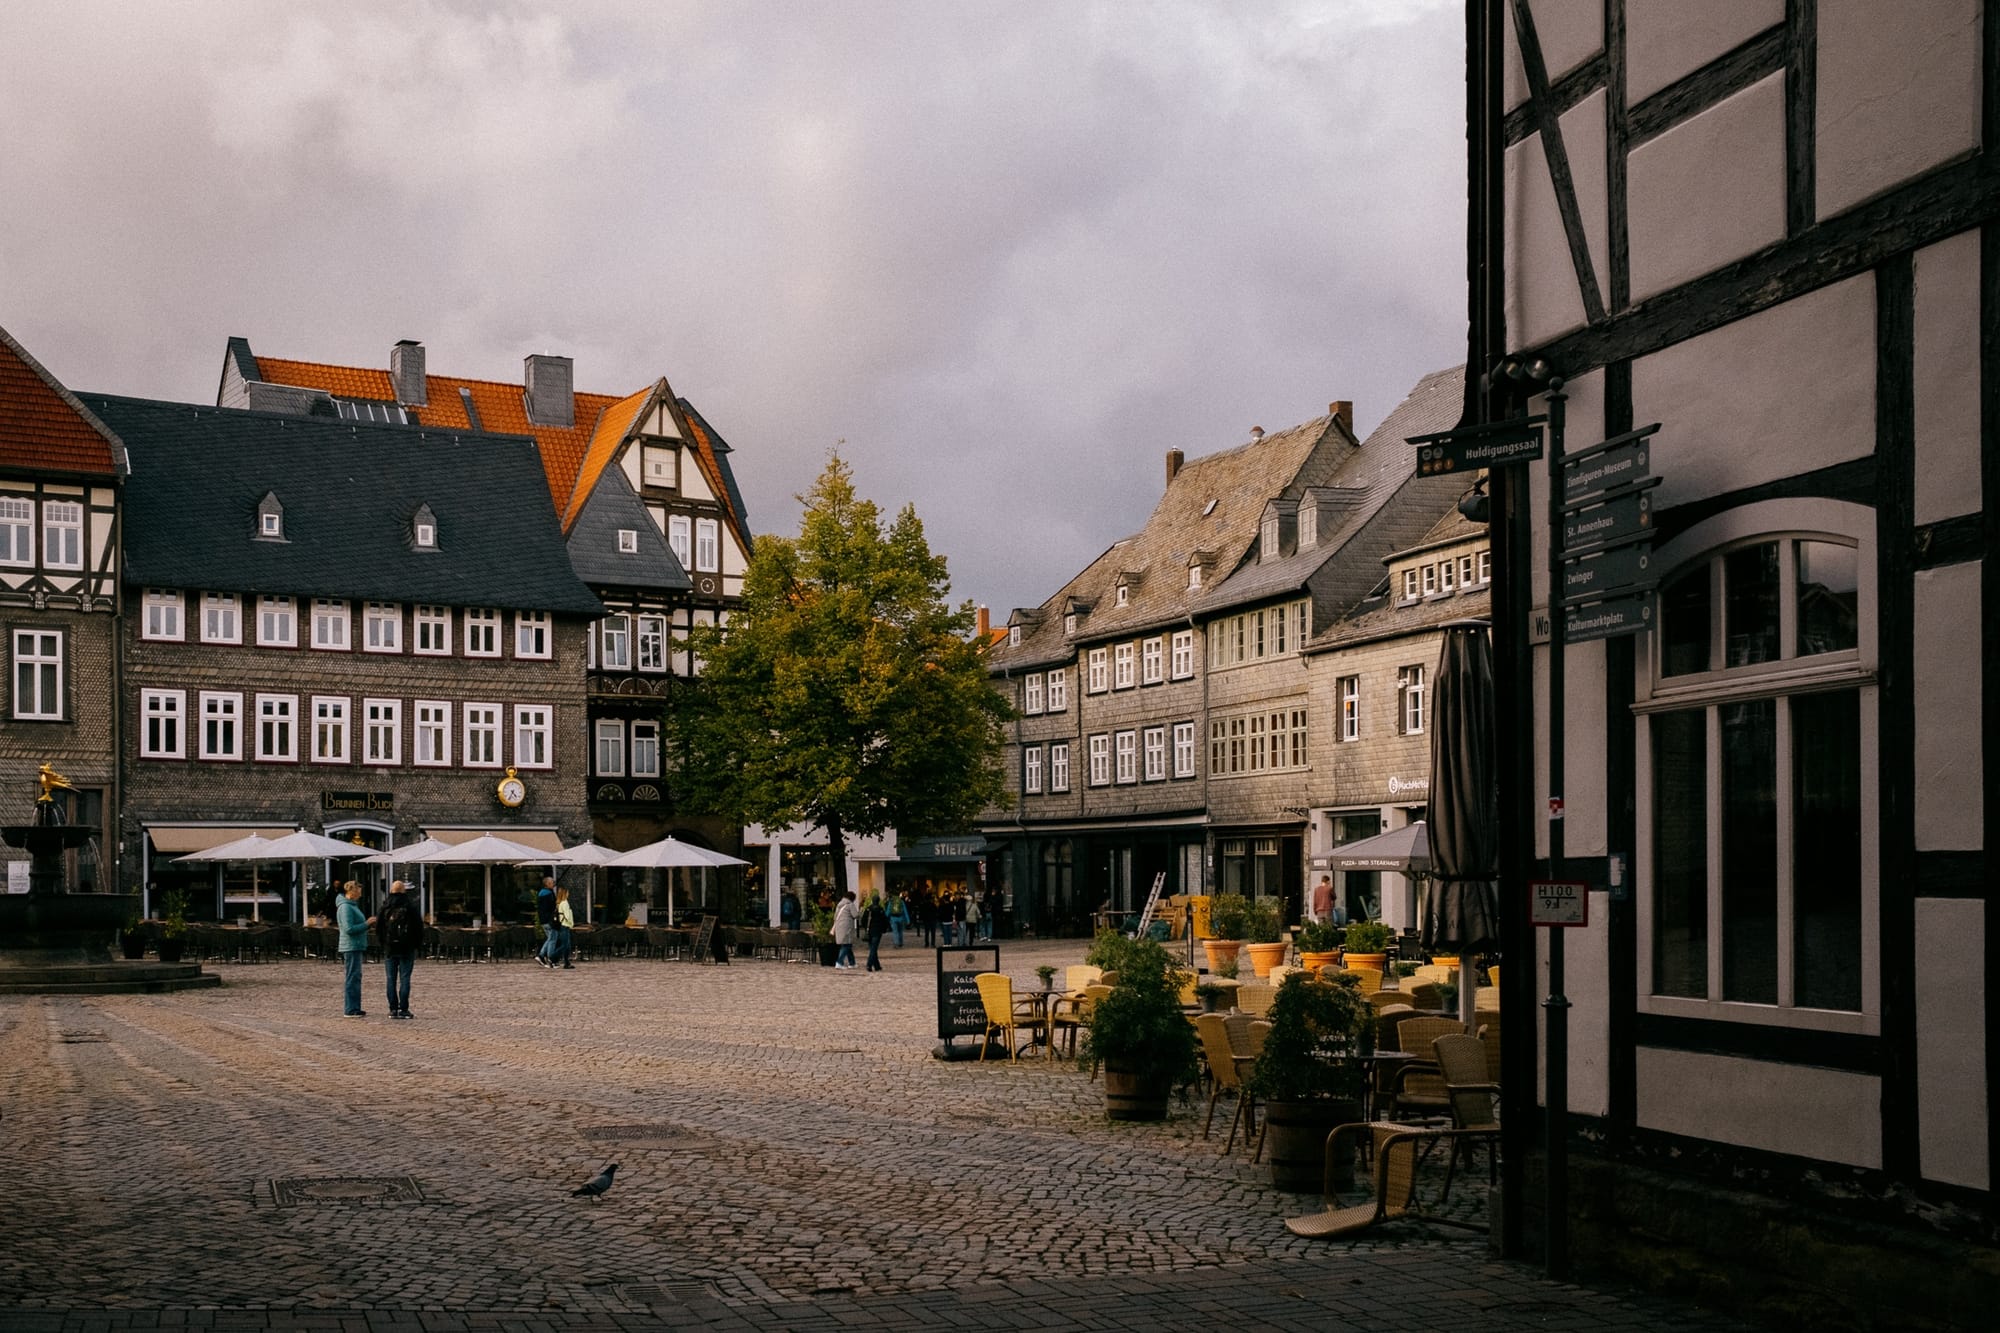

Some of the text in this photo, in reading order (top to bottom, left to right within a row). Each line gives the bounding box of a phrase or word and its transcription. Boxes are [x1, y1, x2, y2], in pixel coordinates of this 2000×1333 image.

[1465, 436, 1539, 460] Huldigungssaal
[1567, 458, 1632, 488] Zinnfiguren-Museum
[1567, 515, 1614, 538] St. Annenhaus
[1567, 569, 1594, 585] Zwinger
[1567, 612, 1624, 632] Kulturmarktplatz
[1358, 859, 1369, 867] UND
[1370, 859, 1400, 867] STEAKHAUS
[1538, 886, 1572, 896] H100
[949, 986, 980, 996] schma
